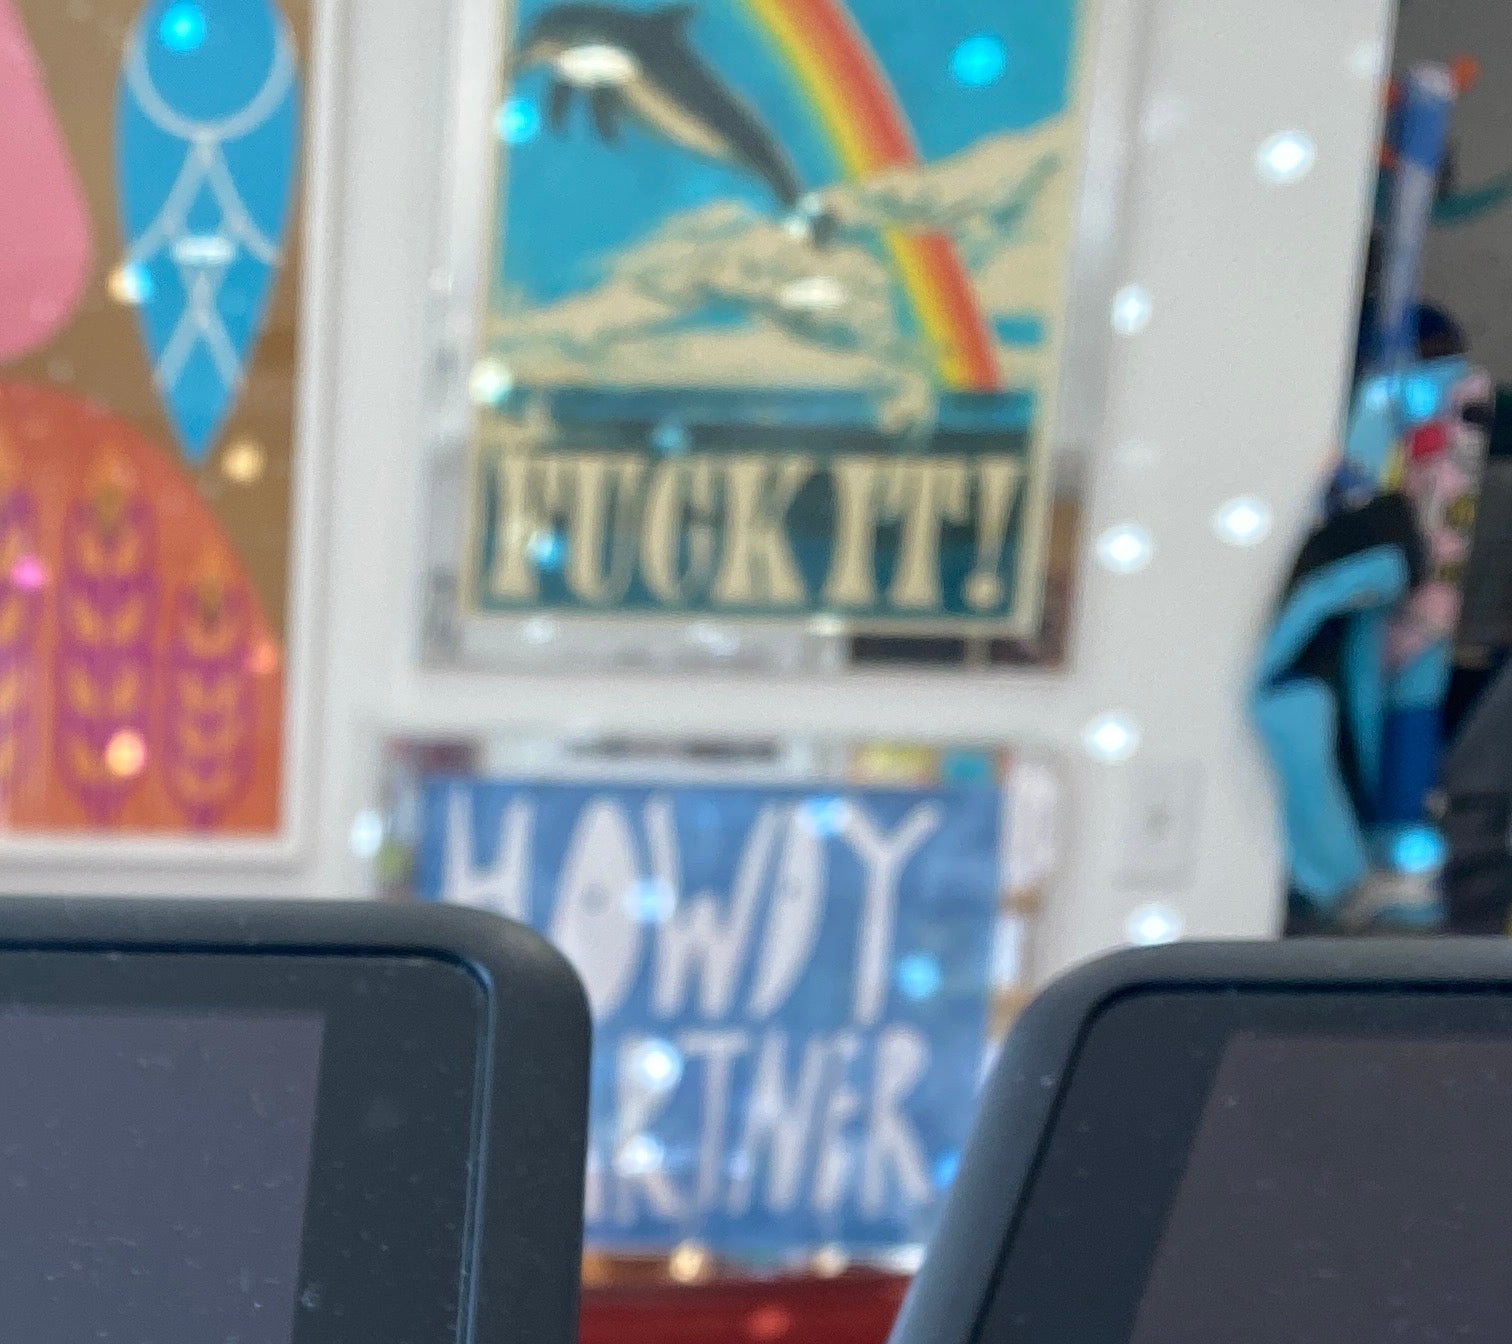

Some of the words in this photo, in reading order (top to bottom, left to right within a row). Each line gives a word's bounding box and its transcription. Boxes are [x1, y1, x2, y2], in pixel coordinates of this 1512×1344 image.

[491, 450, 816, 602] FUCK
[823, 454, 1026, 608] IT!
[442, 790, 942, 1028] HOWDY
[588, 1022, 936, 1228] RTNER
